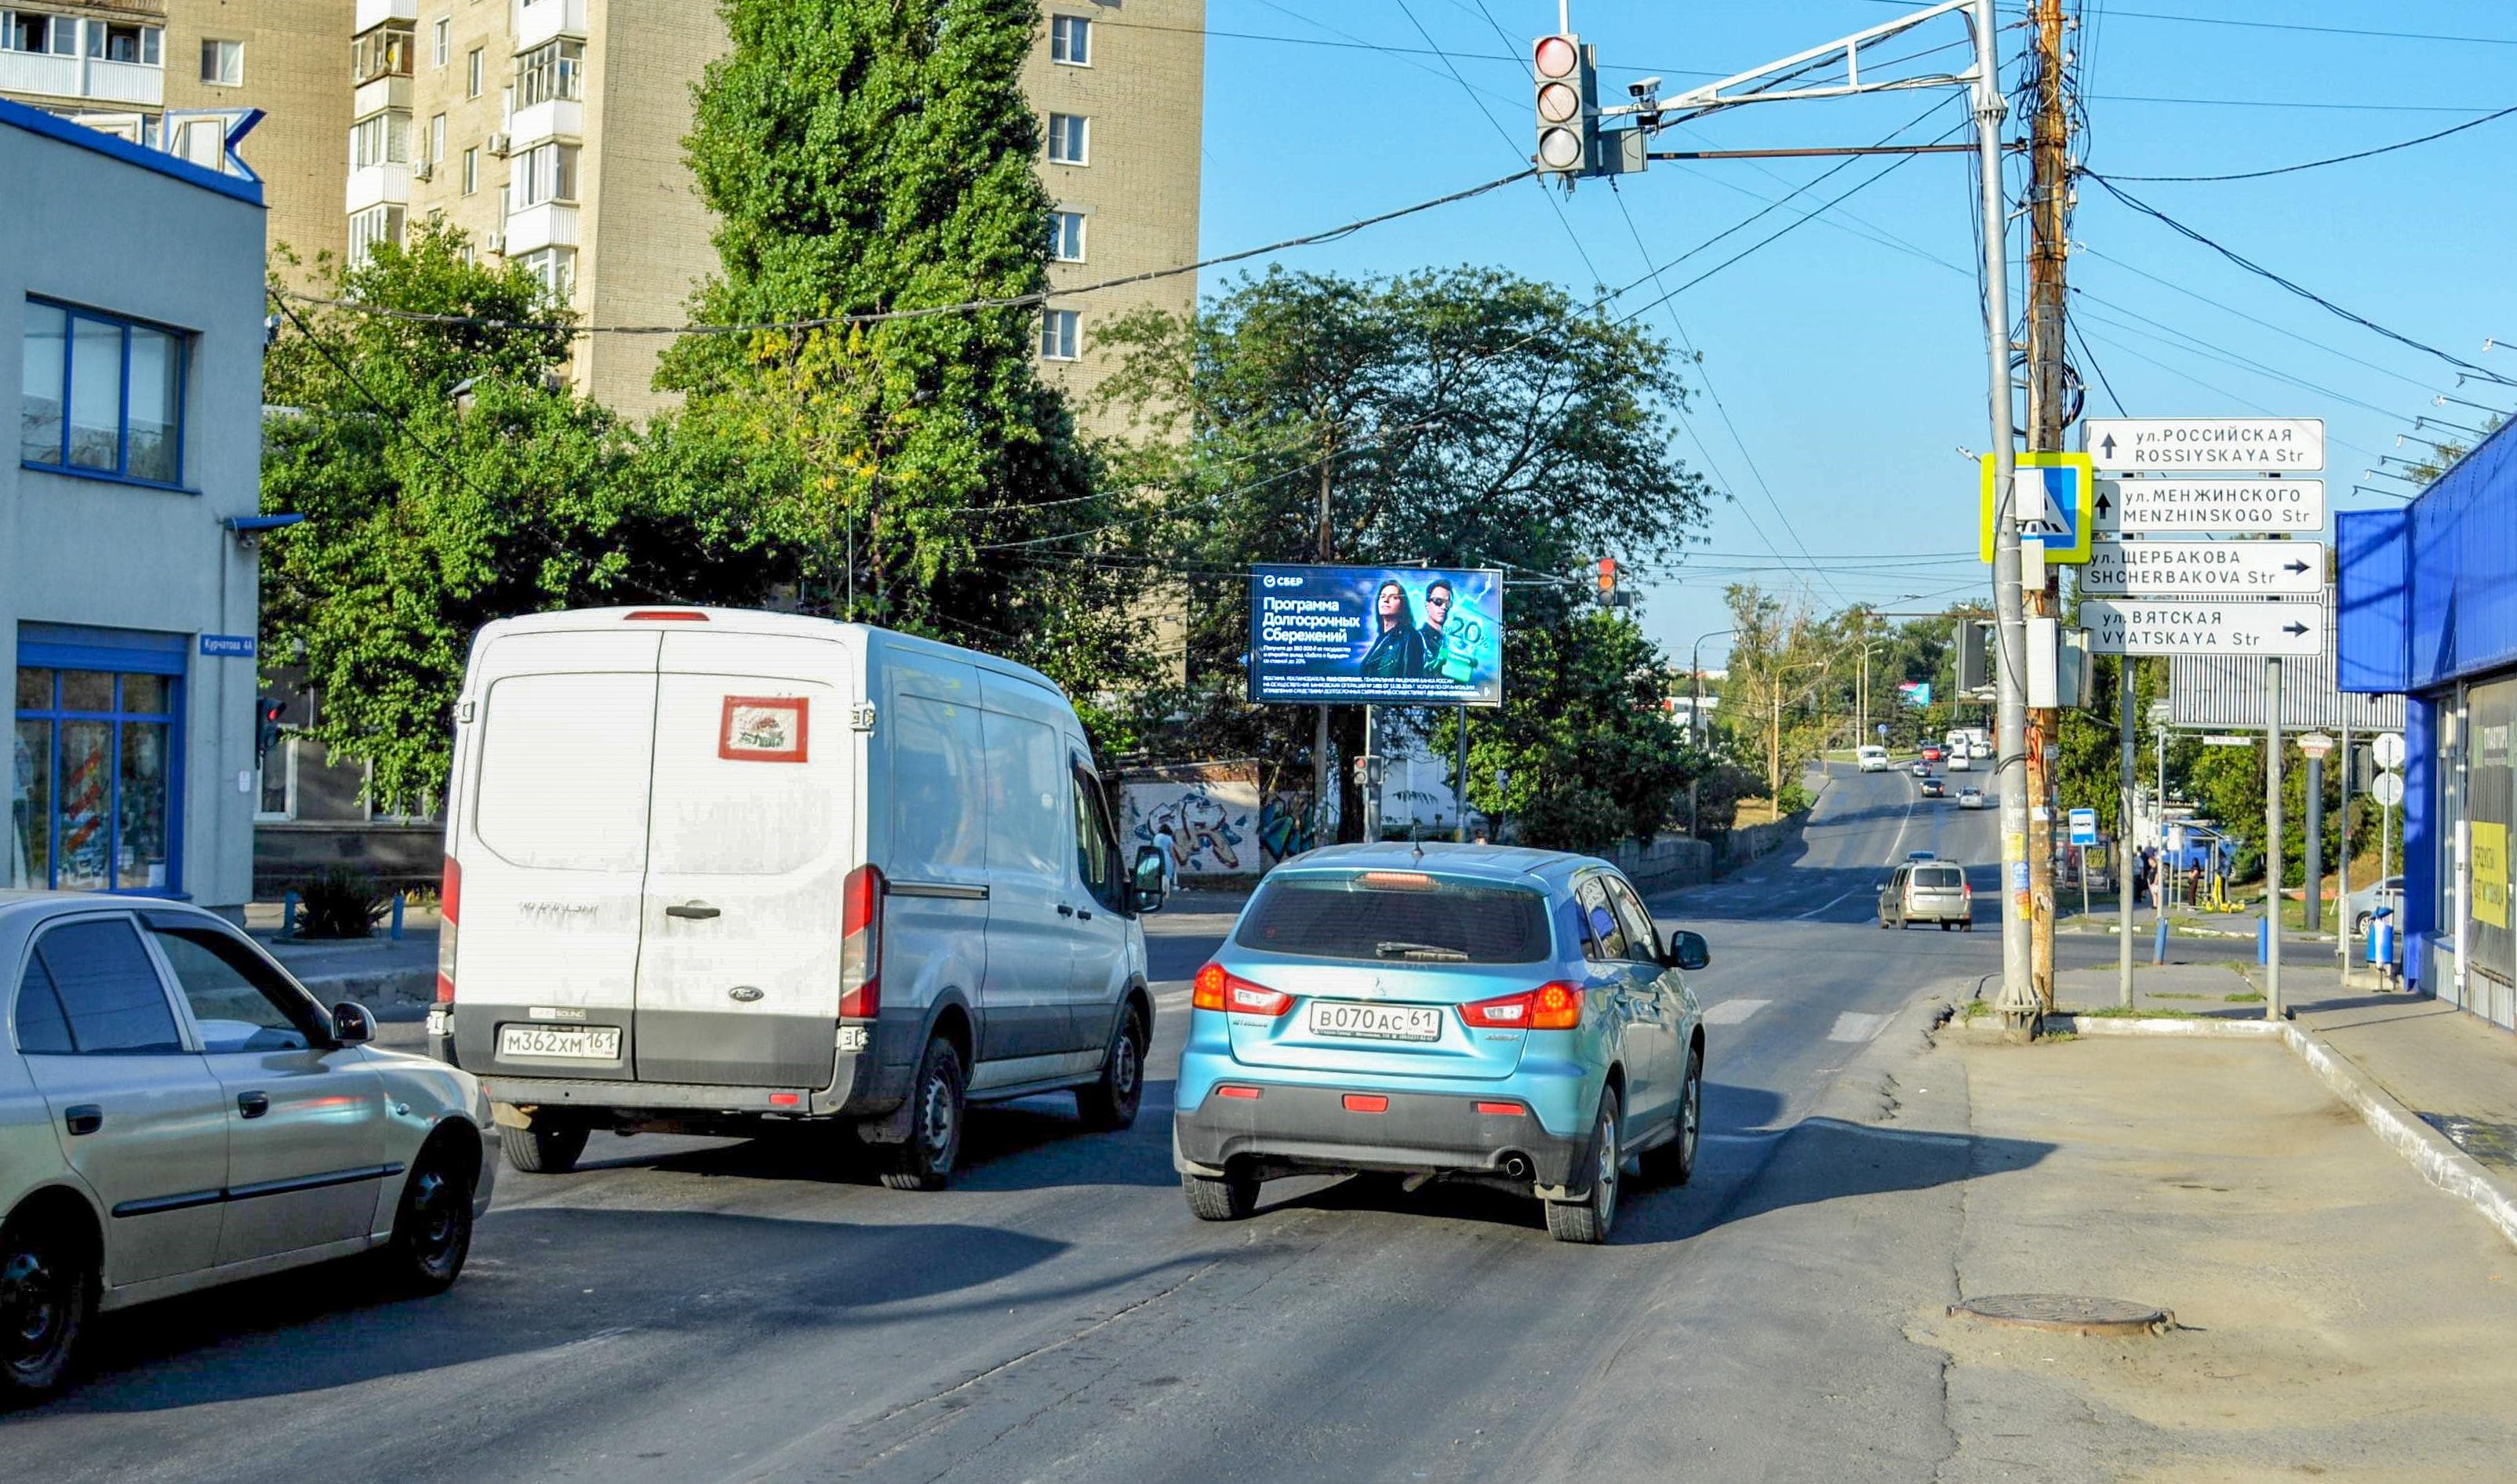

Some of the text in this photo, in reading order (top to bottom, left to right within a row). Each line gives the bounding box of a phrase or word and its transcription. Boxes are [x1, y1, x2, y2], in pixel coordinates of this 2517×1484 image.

[2136, 449, 2304, 462] ROSSIYSKAYA Str
[2124, 509, 2310, 522] MENZHINSKOGO Str
[2122, 551, 2240, 566] ЩЕРБАКОВА
[1276, 577, 1304, 587] СБЕР
[2090, 570, 2275, 584] SHCHERBAKOVA Str
[1263, 596, 1340, 613] Программа
[1262, 612, 1361, 629] Долгосрочных
[2133, 611, 2221, 624] ВЯТСКАЯ
[1262, 627, 1348, 644] Сбережений
[2102, 631, 2260, 646] VYATSKAYA Str
[1410, 1011, 1431, 1027] 61
